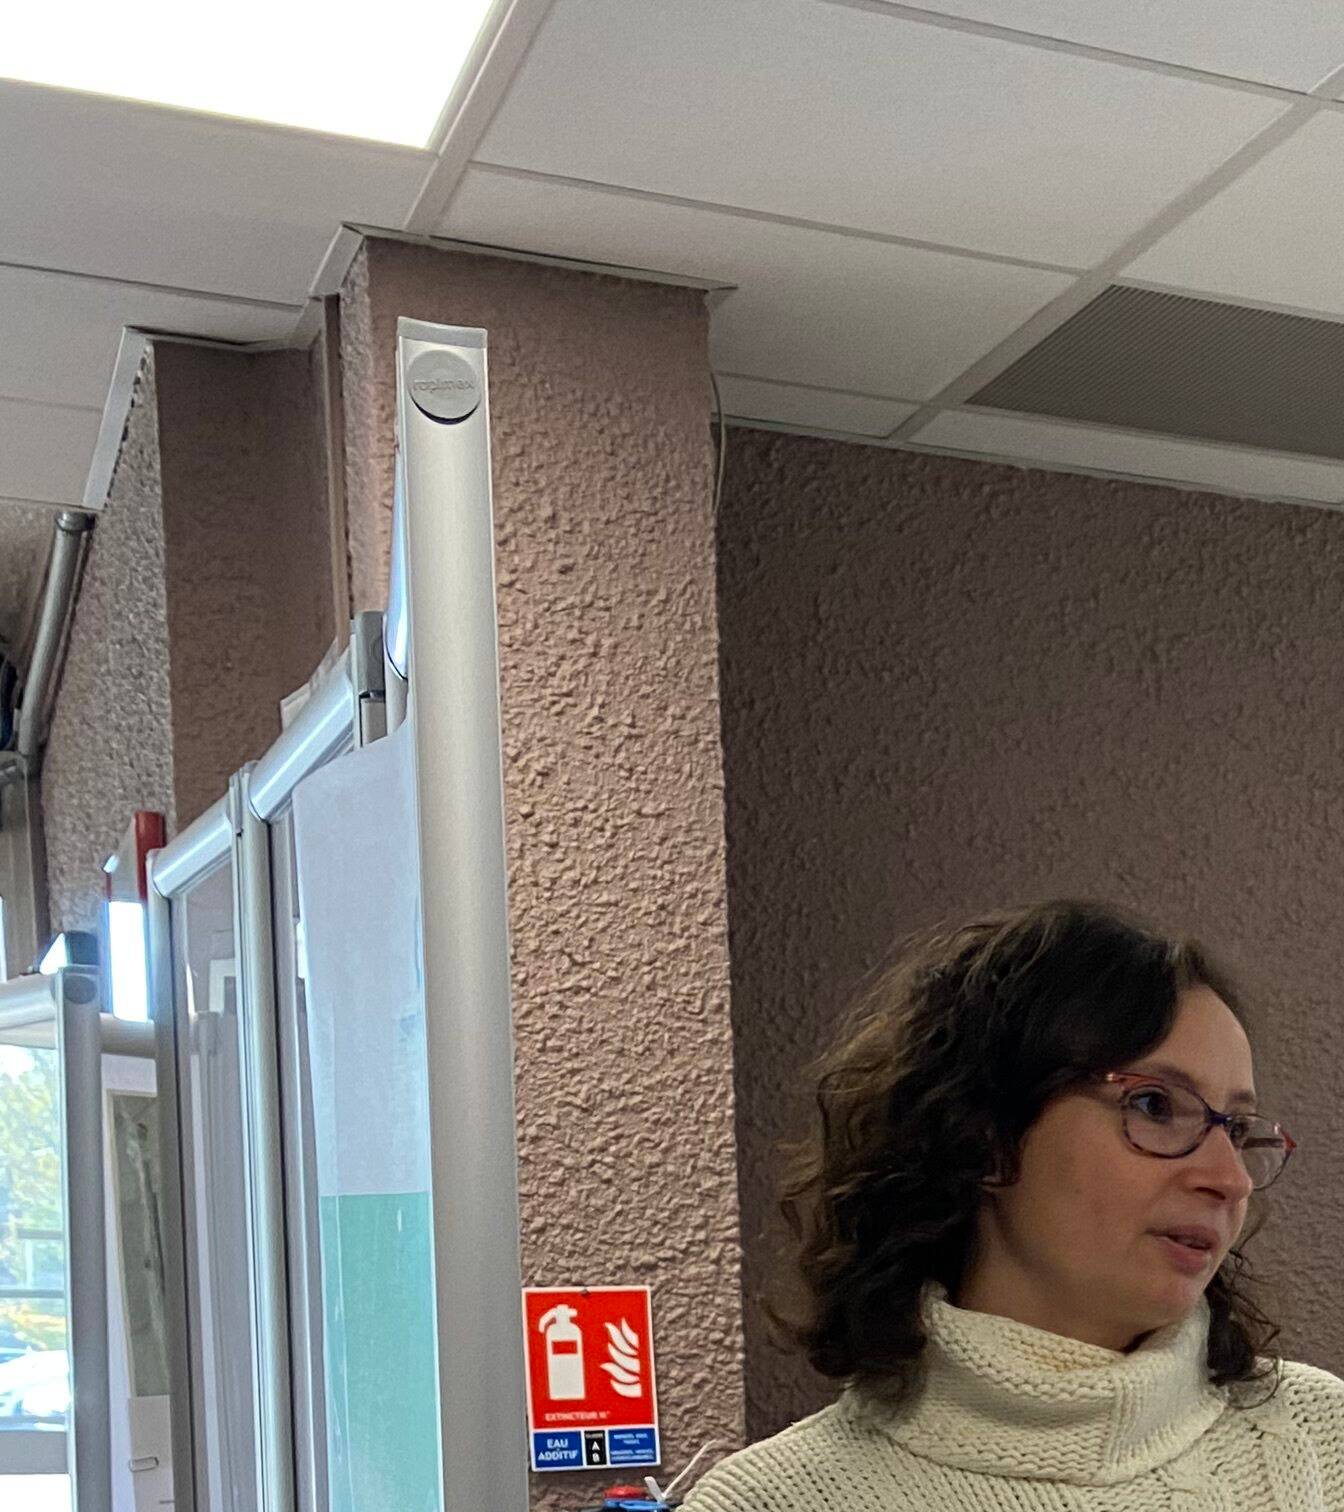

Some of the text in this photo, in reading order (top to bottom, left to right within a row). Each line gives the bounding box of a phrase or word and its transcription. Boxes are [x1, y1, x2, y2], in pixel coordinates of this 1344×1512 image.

[547, 1438, 568, 1449] EAU
[592, 1441, 600, 1450] A
[538, 1449, 578, 1461] ADDITIF
